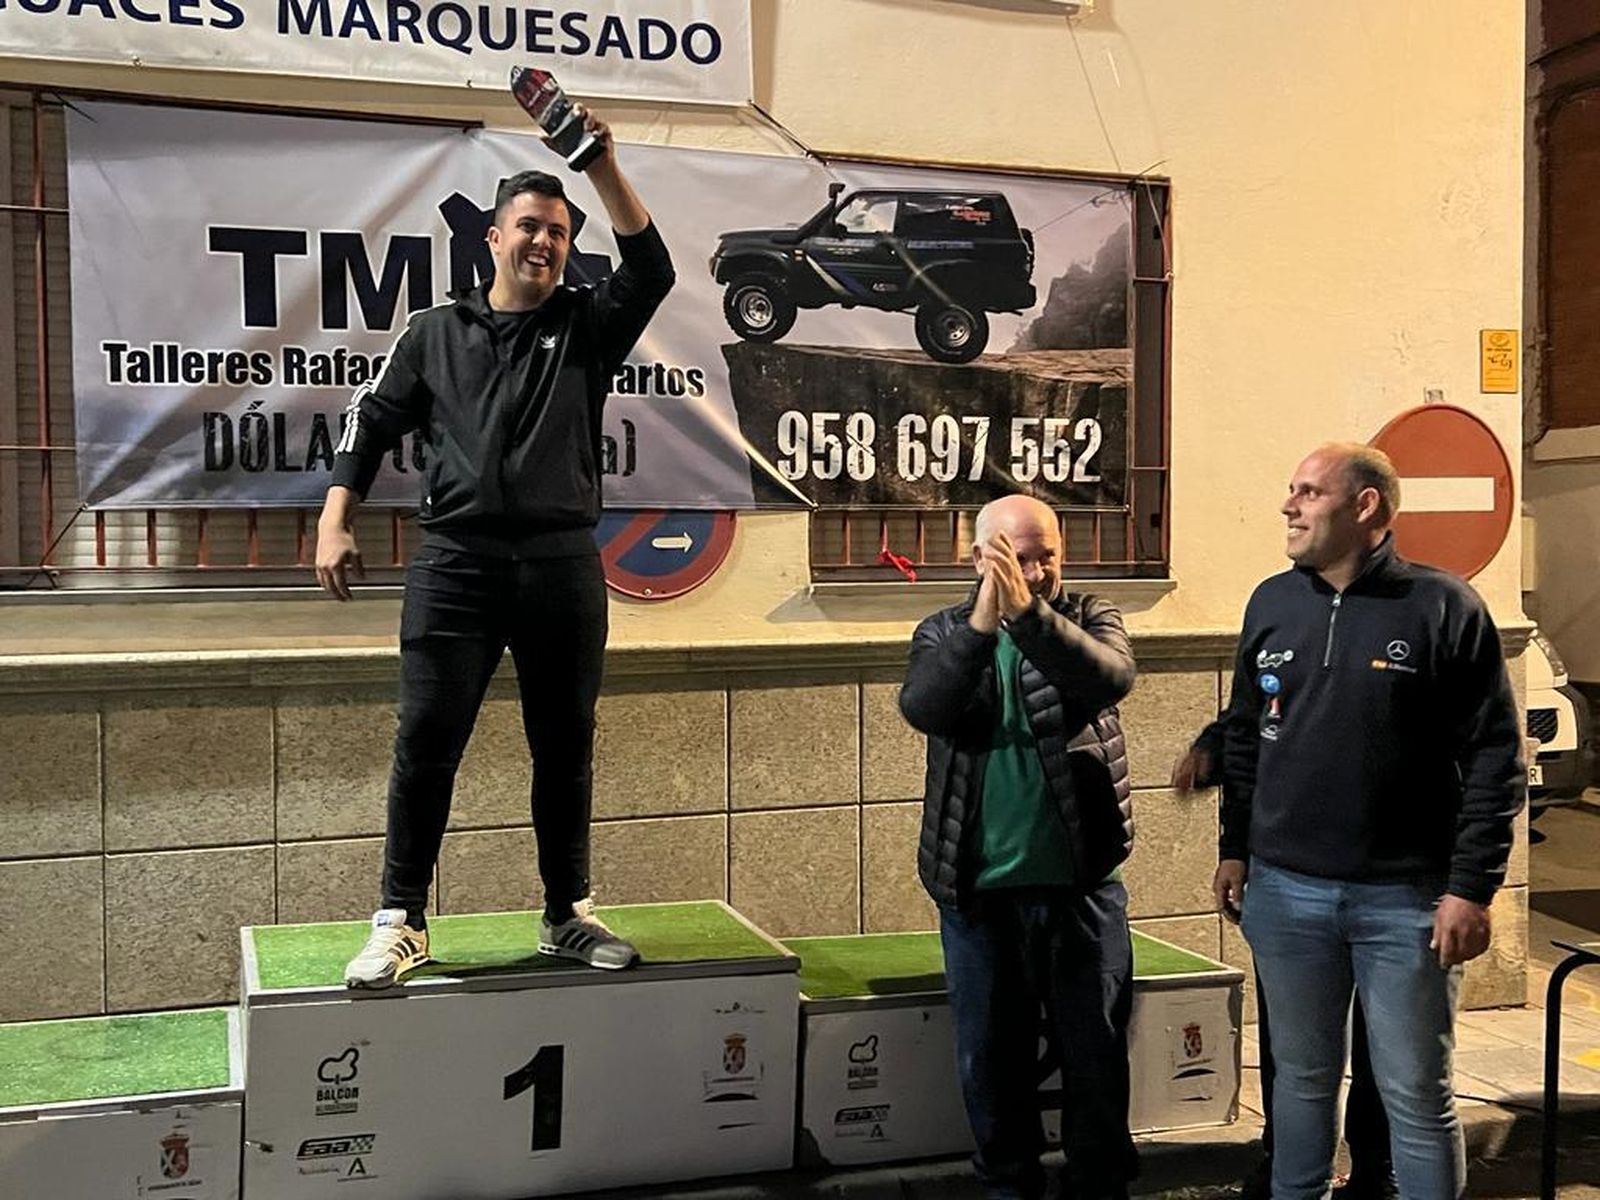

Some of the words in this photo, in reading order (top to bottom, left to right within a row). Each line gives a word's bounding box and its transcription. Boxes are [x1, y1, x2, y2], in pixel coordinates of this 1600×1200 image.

[0, 0, 245, 29] CES
[277, 0, 722, 65] MARQUESADO
[207, 225, 560, 331] TM
[102, 342, 273, 386] Talleres
[608, 361, 705, 398] artos
[203, 400, 346, 473] DÓLA
[777, 410, 876, 482] 958
[897, 413, 991, 483] 697
[1010, 417, 1102, 483] 552
[503, 1044, 565, 1151] 1
